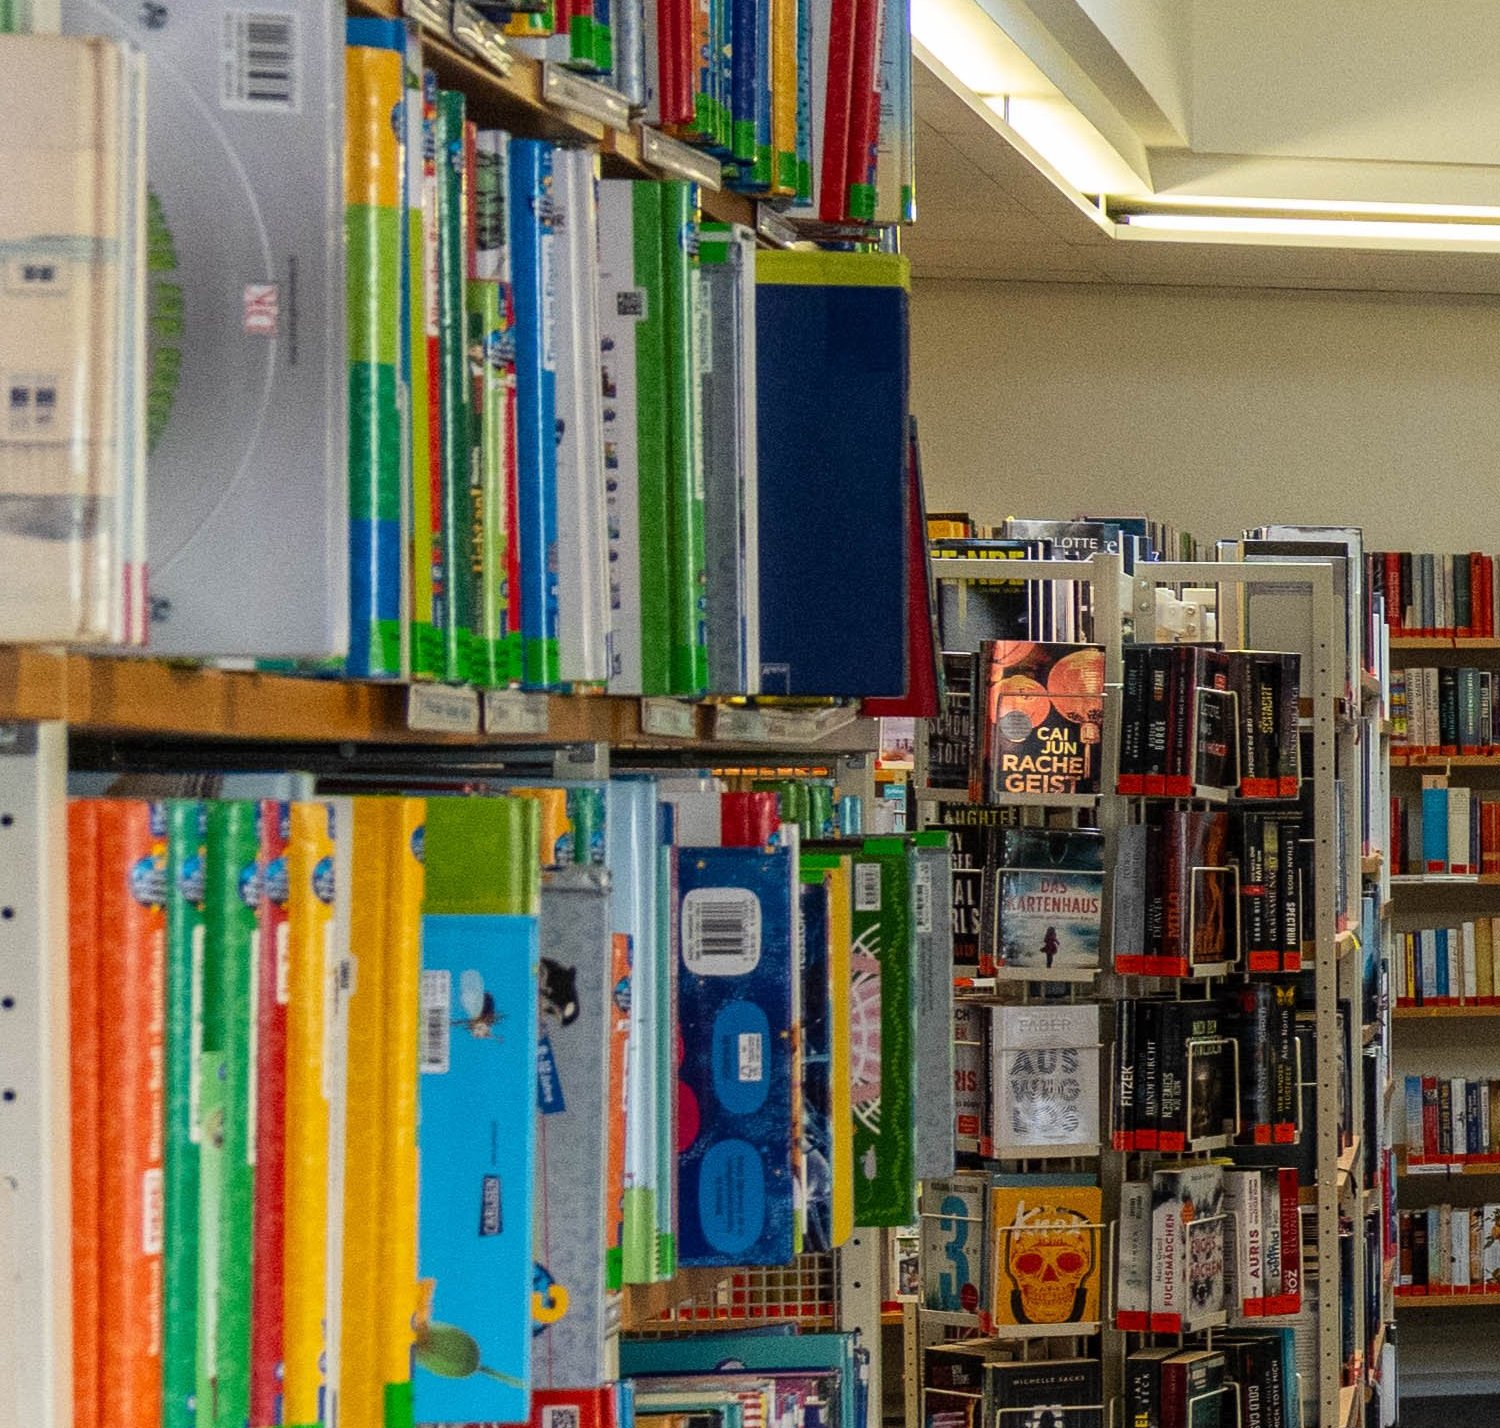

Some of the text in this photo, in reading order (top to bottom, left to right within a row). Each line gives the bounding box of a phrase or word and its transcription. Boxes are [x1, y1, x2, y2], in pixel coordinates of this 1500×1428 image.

[1037, 727, 1068, 741] CAI
[1041, 741, 1077, 755] JUN
[1002, 754, 1083, 774] RACHE
[1005, 774, 1080, 794] GEIST
[1040, 881, 1068, 894] DAS
[1004, 898, 1099, 914] KARTENHAUS
[1121, 1065, 1134, 1106] FITZEK
[1164, 1213, 1175, 1307] FUCHSMÄDCHEN
[1249, 1229, 1260, 1279] AURIS
